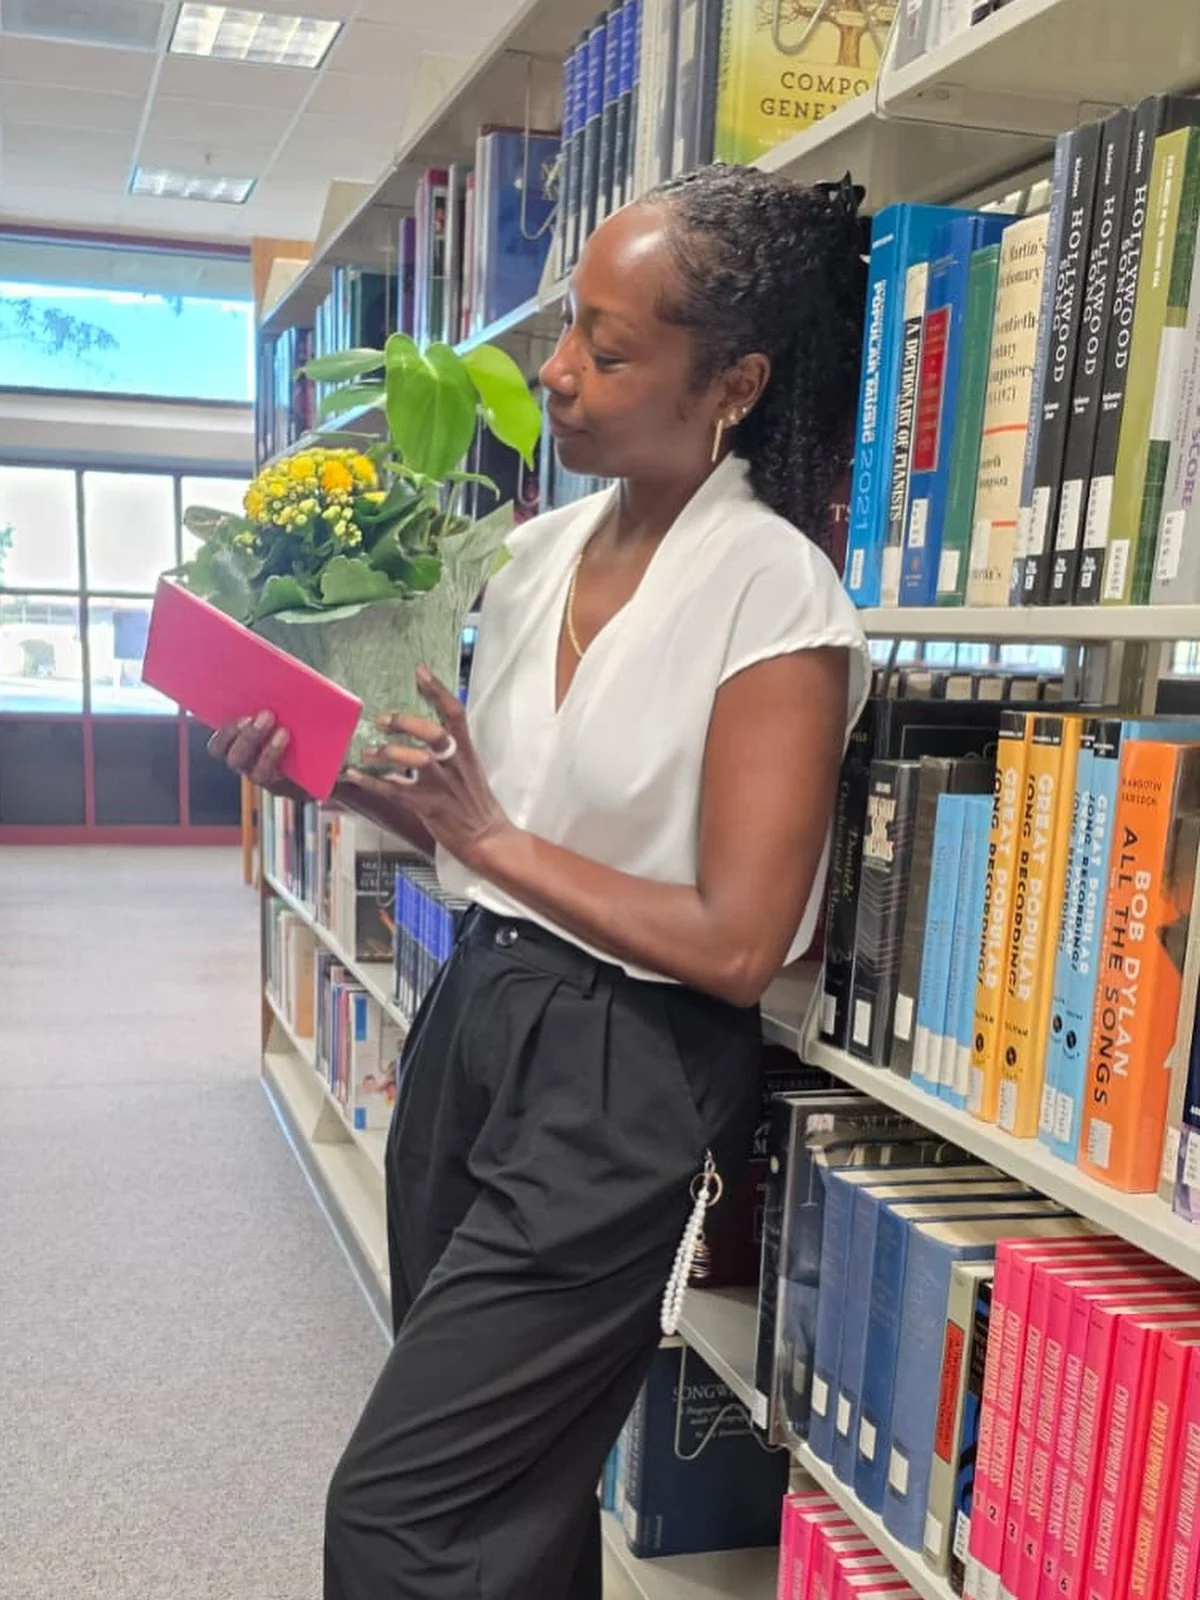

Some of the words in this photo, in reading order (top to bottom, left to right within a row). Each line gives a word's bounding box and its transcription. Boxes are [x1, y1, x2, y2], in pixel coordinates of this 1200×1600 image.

[1052, 258, 1069, 331] SONG
[1053, 207, 1084, 383] HOLLYWOOD
[1083, 248, 1102, 323] SONG
[1084, 195, 1116, 375] HOLLYWOOD
[1112, 238, 1133, 316] SONG
[1115, 183, 1148, 369] HOLLYWOOD
[905, 322, 921, 337] A
[897, 338, 919, 430] DICTIONARY
[895, 430, 911, 450] OF
[856, 448, 874, 531] 2021
[999, 767, 1017, 856] GREAT
[1030, 774, 1054, 865] GREAT
[1091, 794, 1108, 866] GREAT
[1118, 825, 1139, 889] ALL
[985, 868, 1009, 989] POPULAR
[1018, 878, 1043, 1001] POPULAR
[1080, 878, 1099, 975] POPULAR
[1108, 905, 1130, 970] THE
[1129, 868, 1152, 942] BOB
[1093, 984, 1120, 1106] SONGS
[1111, 956, 1141, 1077] DYLAN
[988, 1504, 998, 1521] 2
[1059, 1577, 1068, 1593] 6
